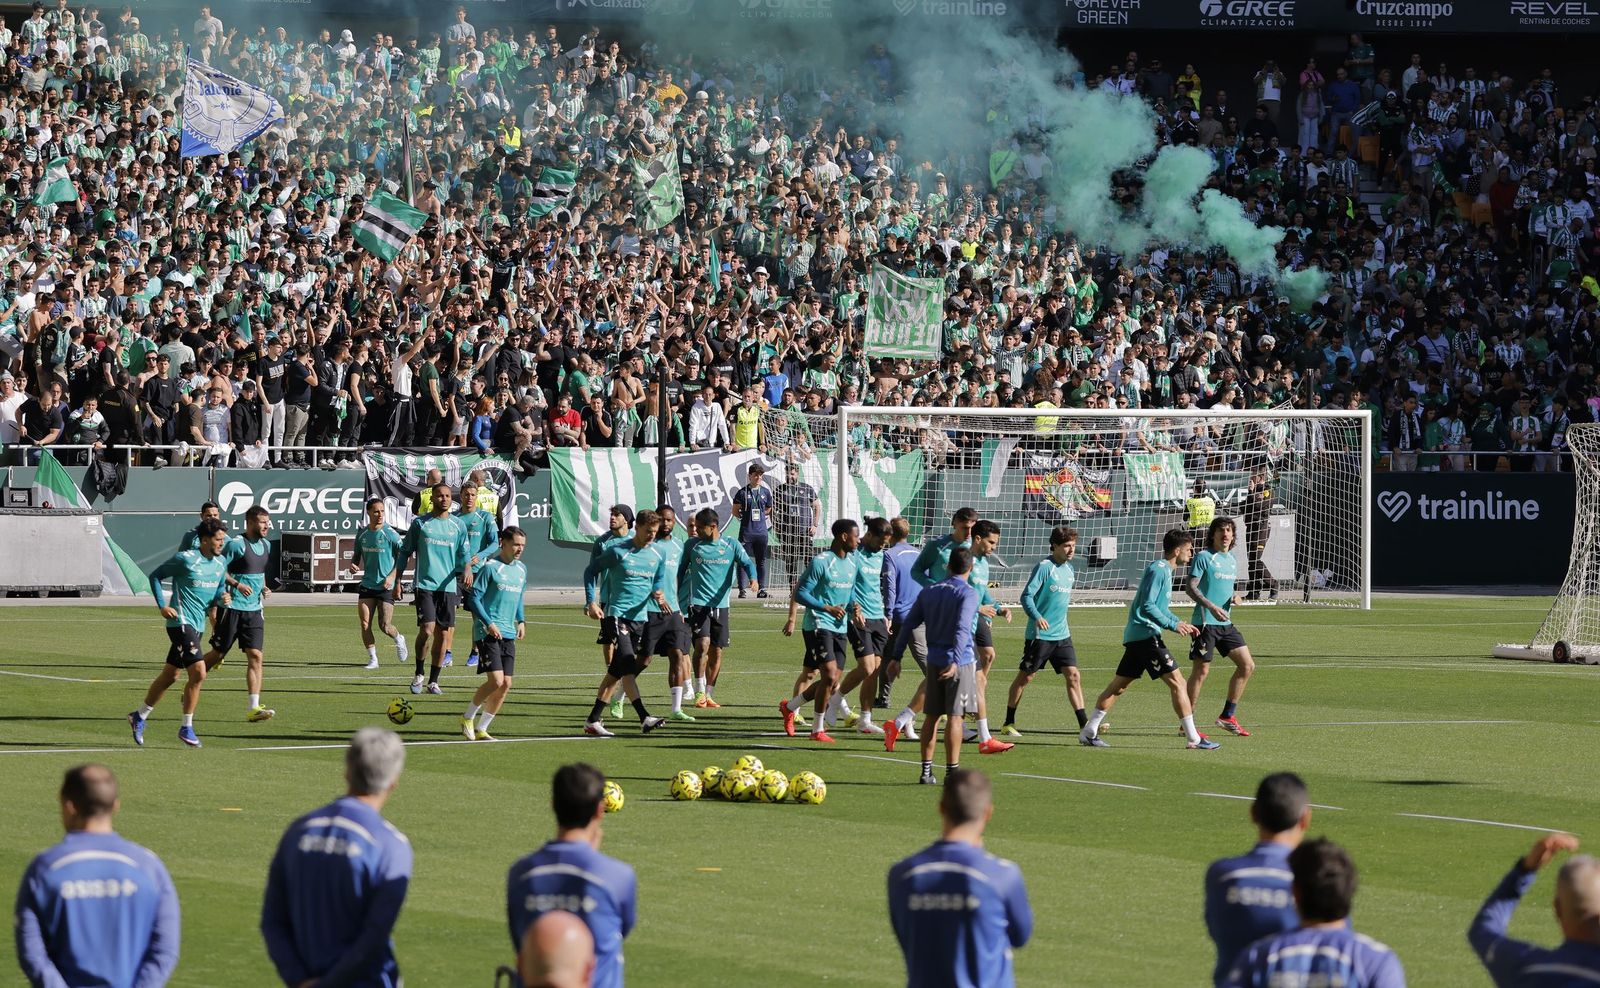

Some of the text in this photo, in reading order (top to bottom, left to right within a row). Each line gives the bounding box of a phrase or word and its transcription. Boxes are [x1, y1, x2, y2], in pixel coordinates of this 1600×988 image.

[922, 0, 1006, 16] trainline
[1226, 1, 1296, 17] GREE
[1356, 0, 1453, 19] Cruzcampo
[1511, 2, 1599, 15] REVEL
[1077, 10, 1128, 25] GREEN
[1201, 17, 1295, 26] CLIMATIZACIÓN
[1376, 19, 1404, 27] DESDE
[260, 488, 365, 514] GREE
[1418, 490, 1540, 520] trainline
